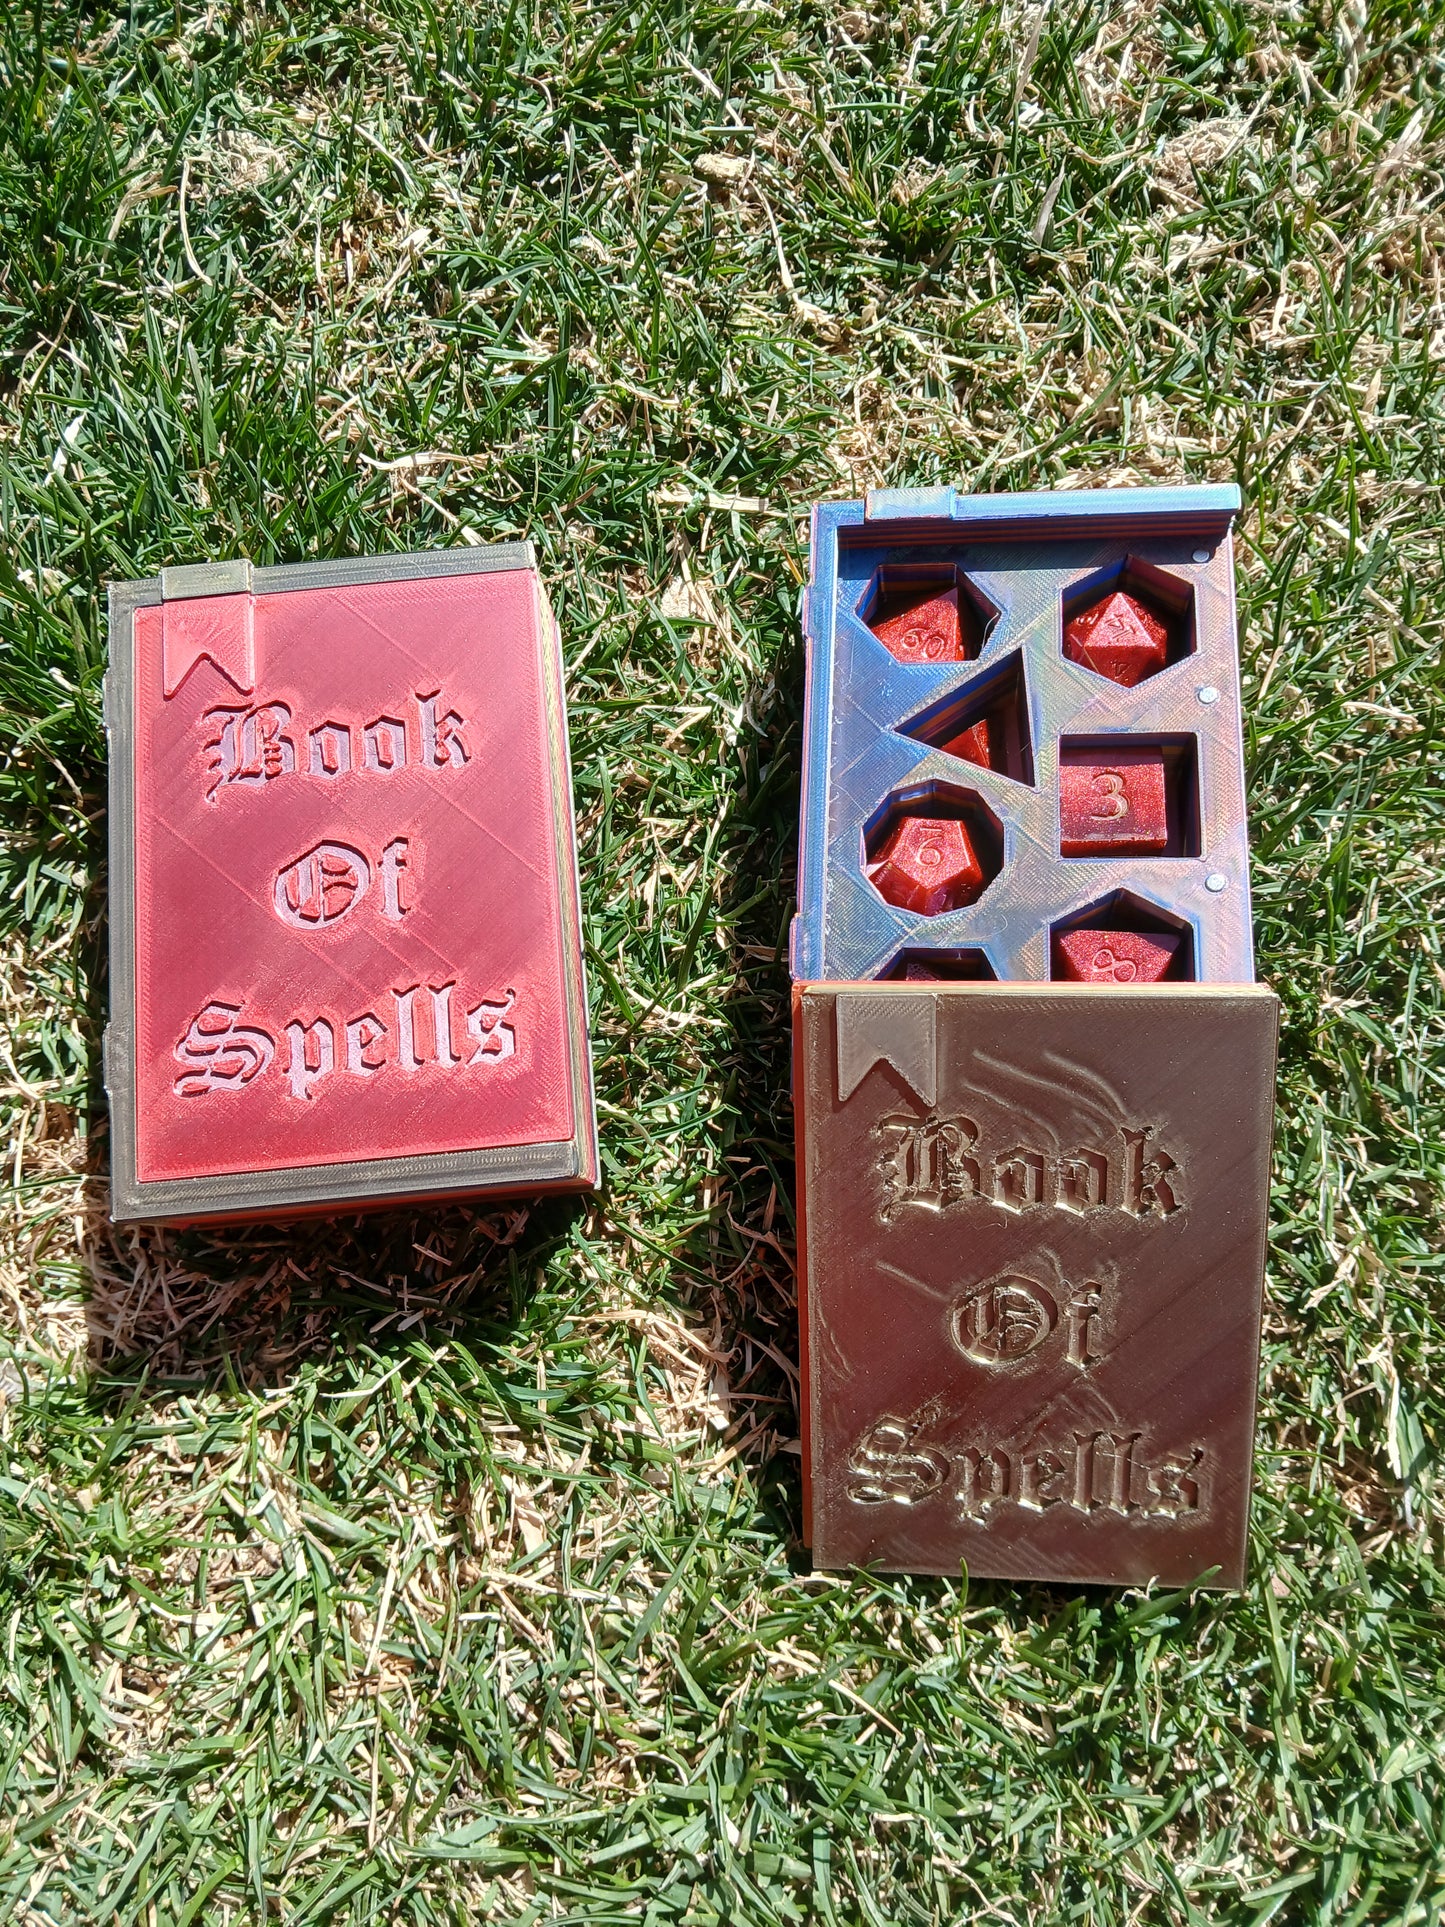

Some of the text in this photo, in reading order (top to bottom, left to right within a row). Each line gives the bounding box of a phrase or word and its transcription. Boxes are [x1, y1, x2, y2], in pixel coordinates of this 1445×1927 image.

[201, 688, 472, 805] Book
[1090, 769, 1129, 821] 3
[273, 836, 413, 930] Of
[1092, 947, 1137, 983] 8
[172, 980, 519, 1100] Spells
[875, 1114, 1185, 1225] Book
[949, 1272, 1104, 1369] Of
[846, 1414, 1205, 1526] Spells
